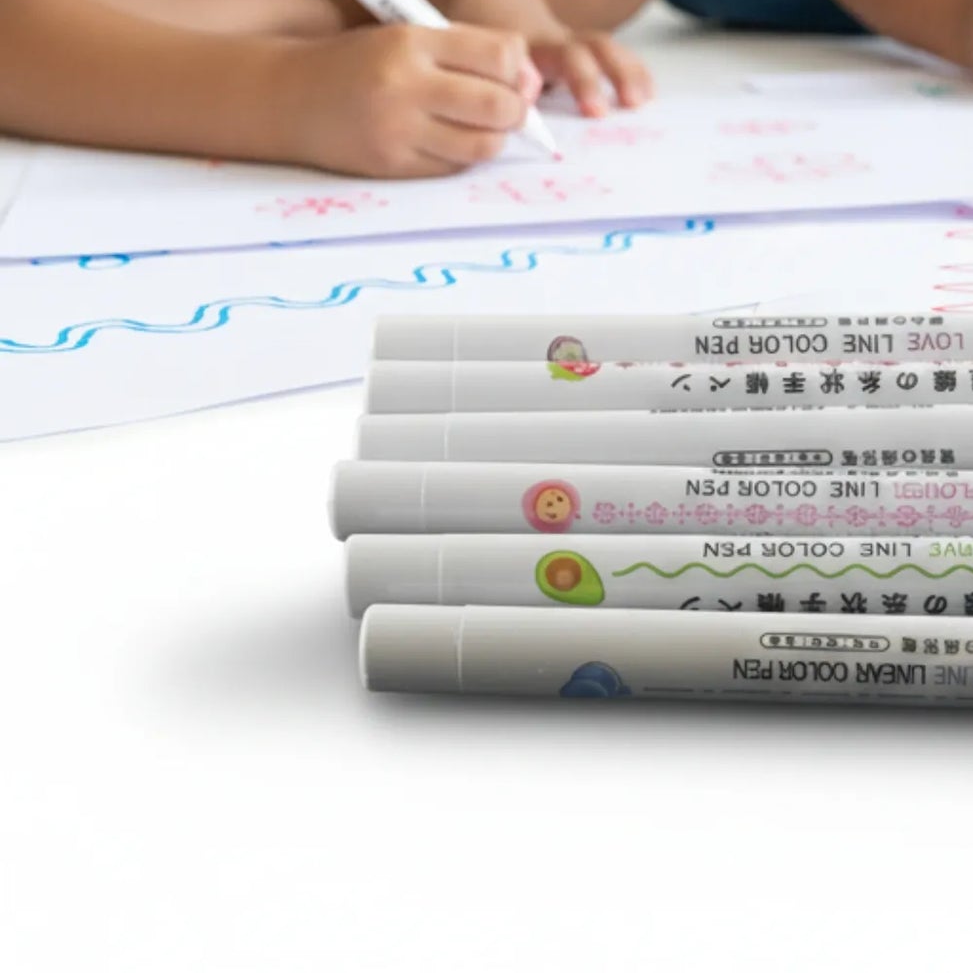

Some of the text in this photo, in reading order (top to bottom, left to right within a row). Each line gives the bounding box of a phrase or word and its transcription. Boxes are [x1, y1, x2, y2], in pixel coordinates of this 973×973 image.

[694, 332, 964, 355] LOVE LINE COLOR PEN
[737, 480, 817, 498] COLOR
[830, 481, 880, 498] LINE
[760, 542, 845, 558] COLOR
[859, 542, 911, 558] LINE
[732, 659, 773, 681] PEN
[855, 662, 927, 685] LINEAR
